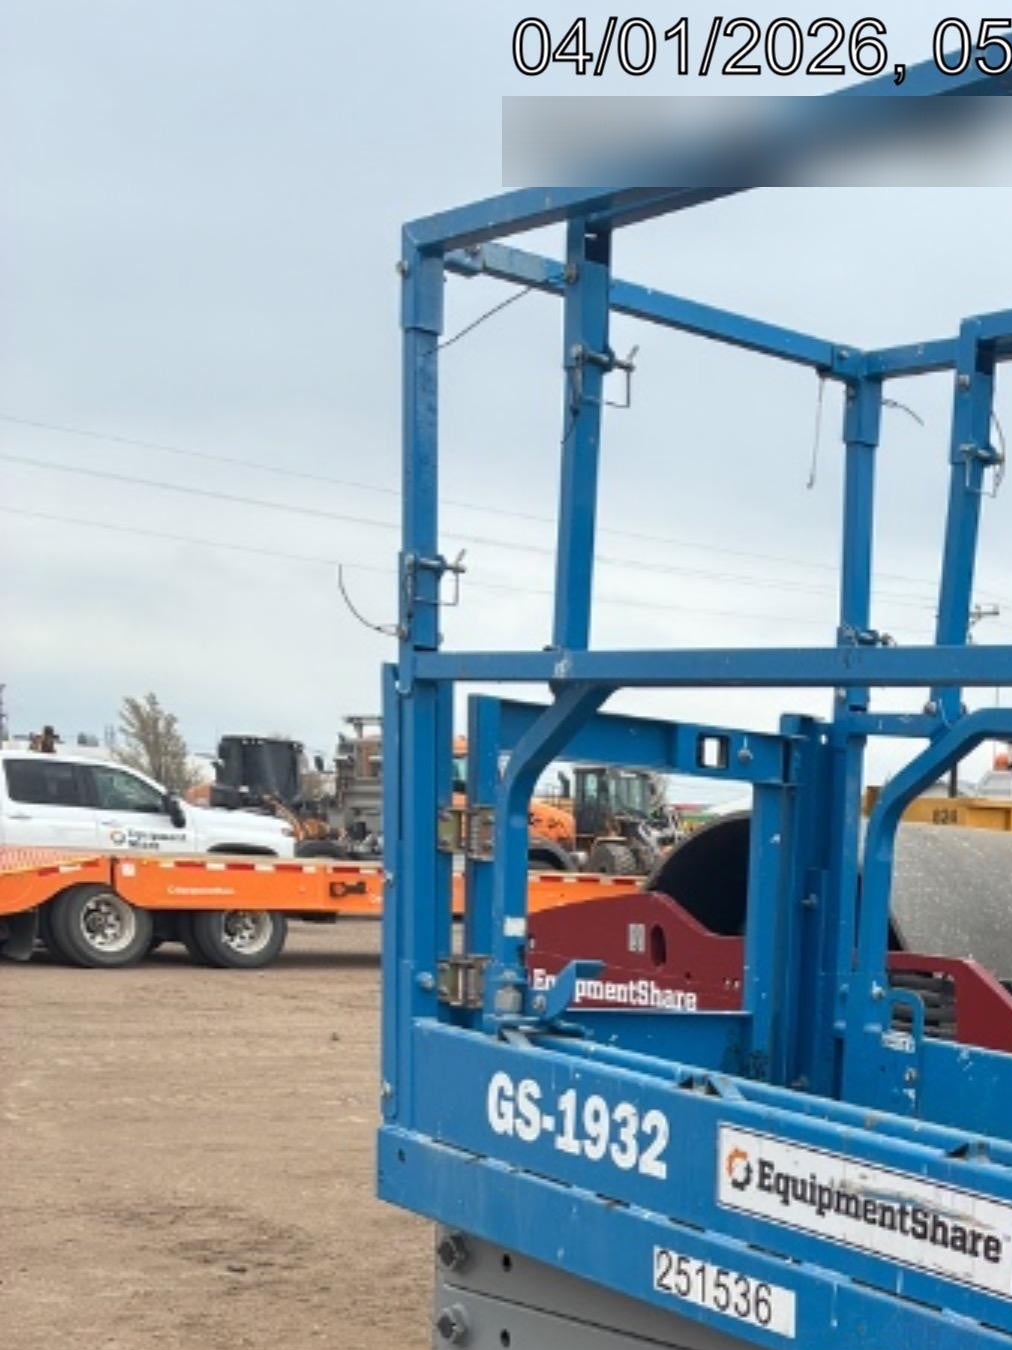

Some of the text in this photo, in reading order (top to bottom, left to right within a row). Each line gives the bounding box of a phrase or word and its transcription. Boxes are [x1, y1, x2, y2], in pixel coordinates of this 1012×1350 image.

[532, 968, 698, 1012] EpmentShare
[487, 1069, 670, 1180] GS-1932
[756, 1157, 1003, 1265] EquipmentShare
[655, 1249, 773, 1326] 251536
